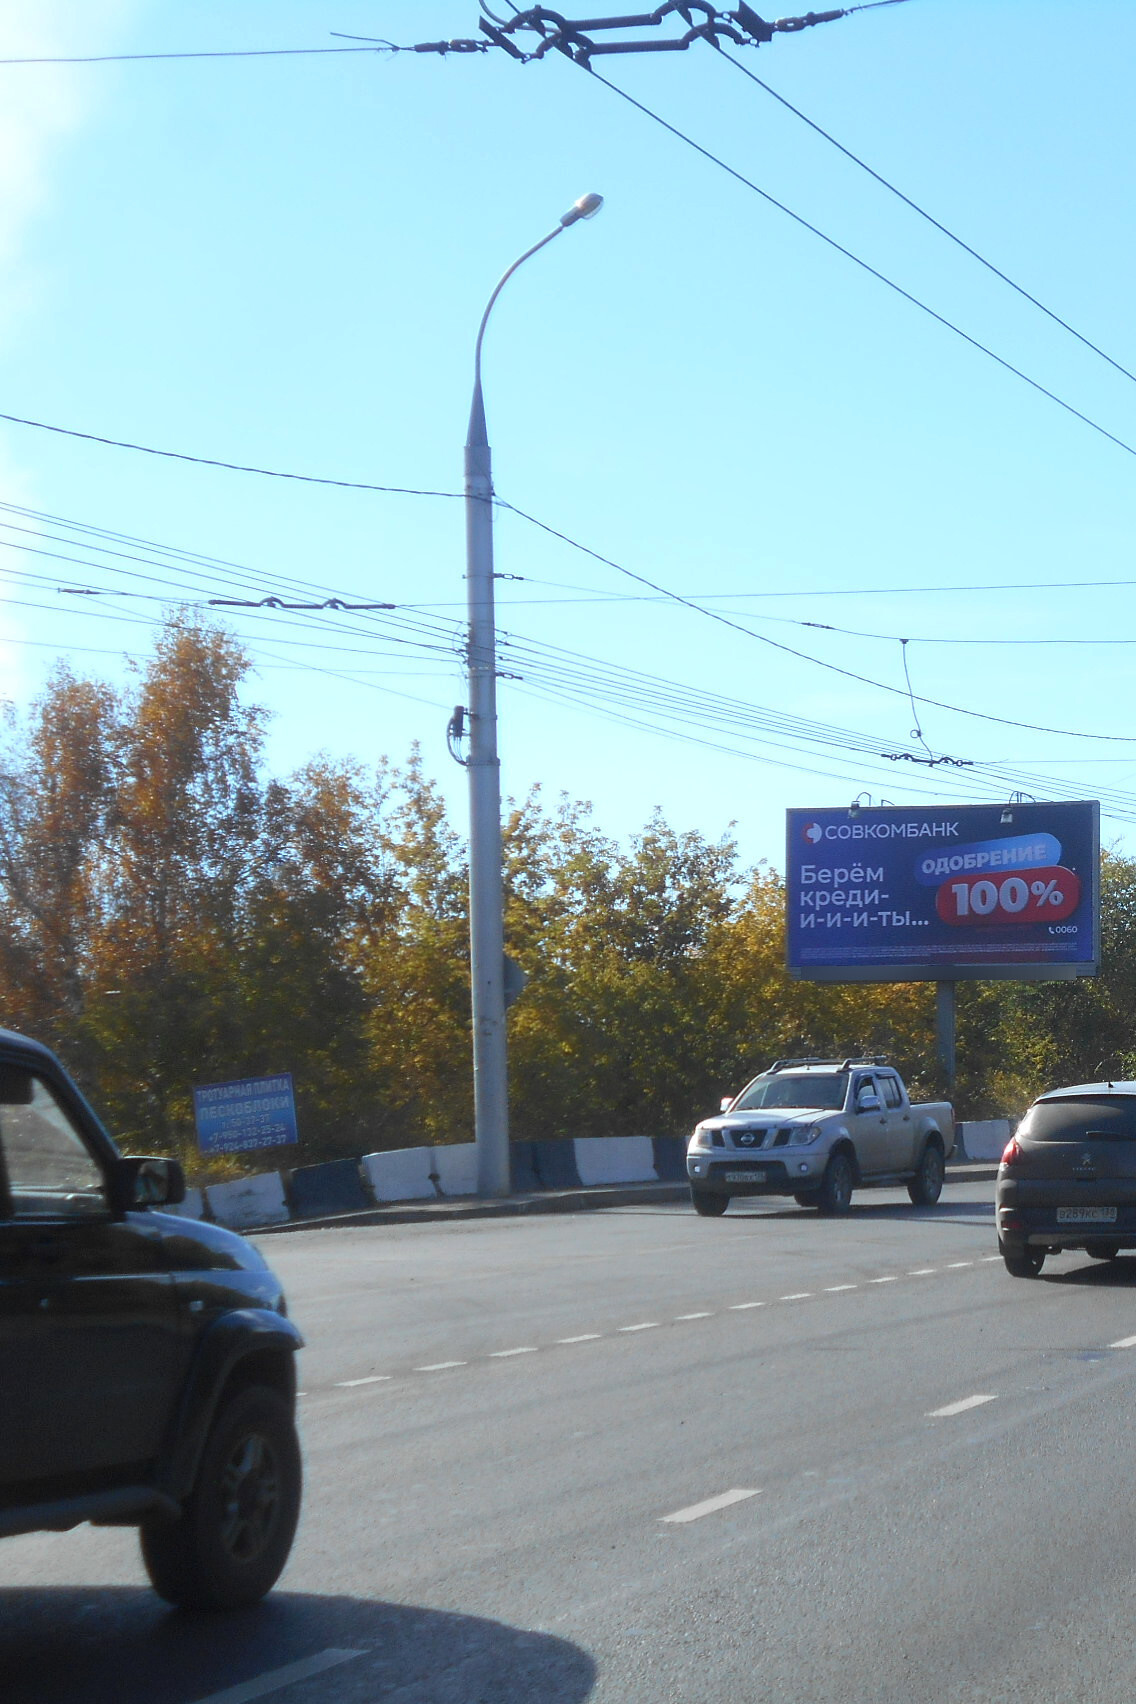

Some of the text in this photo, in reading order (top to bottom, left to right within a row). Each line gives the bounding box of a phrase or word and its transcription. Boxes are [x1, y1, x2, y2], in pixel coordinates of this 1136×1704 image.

[825, 822, 959, 840] СОВКОМБАНК
[921, 843, 1048, 876] ОДОБРЕНИЕ
[800, 862, 884, 888] Берём
[800, 889, 890, 911] креди-
[951, 876, 1064, 916] 100%
[1055, 925, 1078, 934] 0060
[196, 1078, 290, 1102] ТРОТУАРНАЯ ПЛИТКА
[199, 1095, 290, 1121] ПЕСКОБЛОКИ
